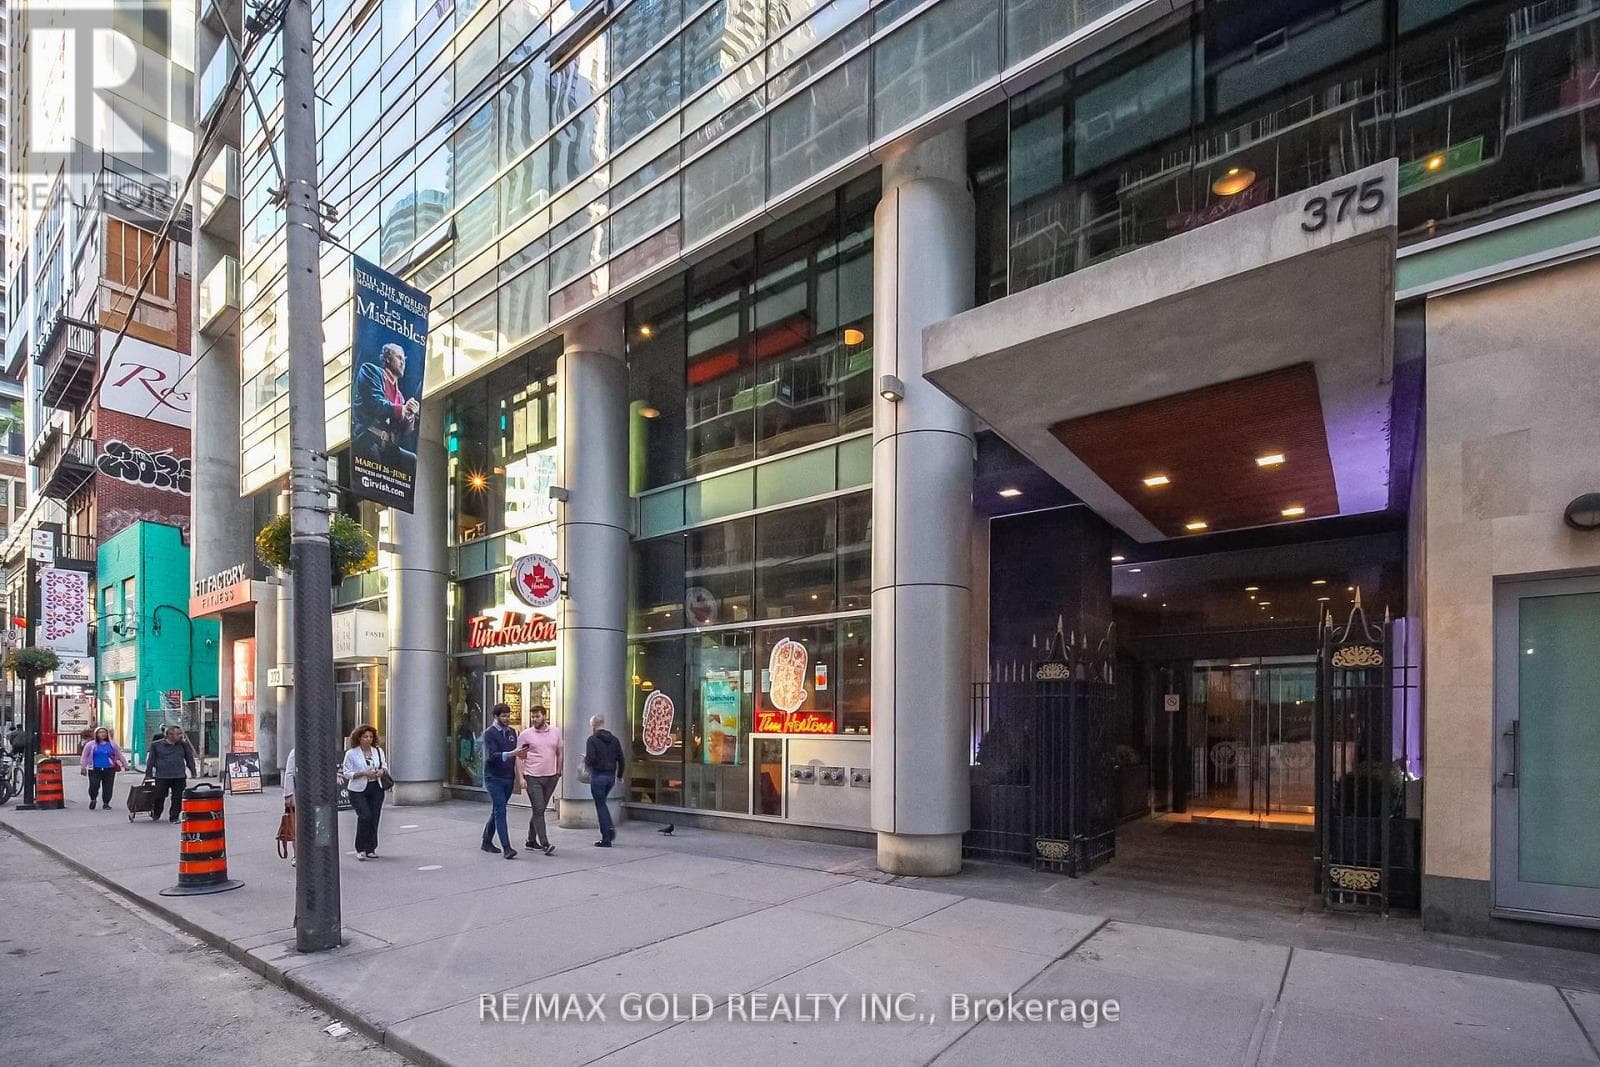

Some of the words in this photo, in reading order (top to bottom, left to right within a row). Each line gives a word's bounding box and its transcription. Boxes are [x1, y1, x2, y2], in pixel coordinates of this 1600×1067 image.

[1301, 176, 1385, 232] 375
[355, 268, 378, 287] STILL
[380, 282, 395, 294] THE
[398, 292, 428, 314] WORLD'S
[356, 276, 374, 290] MOST
[376, 287, 402, 305] POPULAR
[403, 302, 427, 320] MUSICAL
[383, 300, 401, 320] Les
[354, 456, 382, 471] MARCH
[194, 579, 207, 597] FIT
[207, 563, 245, 593] FACTORY
[531, 581, 550, 589] Hortons
[202, 590, 234, 609] FITNESS
[468, 616, 497, 648] Tim
[498, 611, 557, 645] Horton
[758, 712, 781, 733] Tim
[784, 712, 834, 734] Hortons
